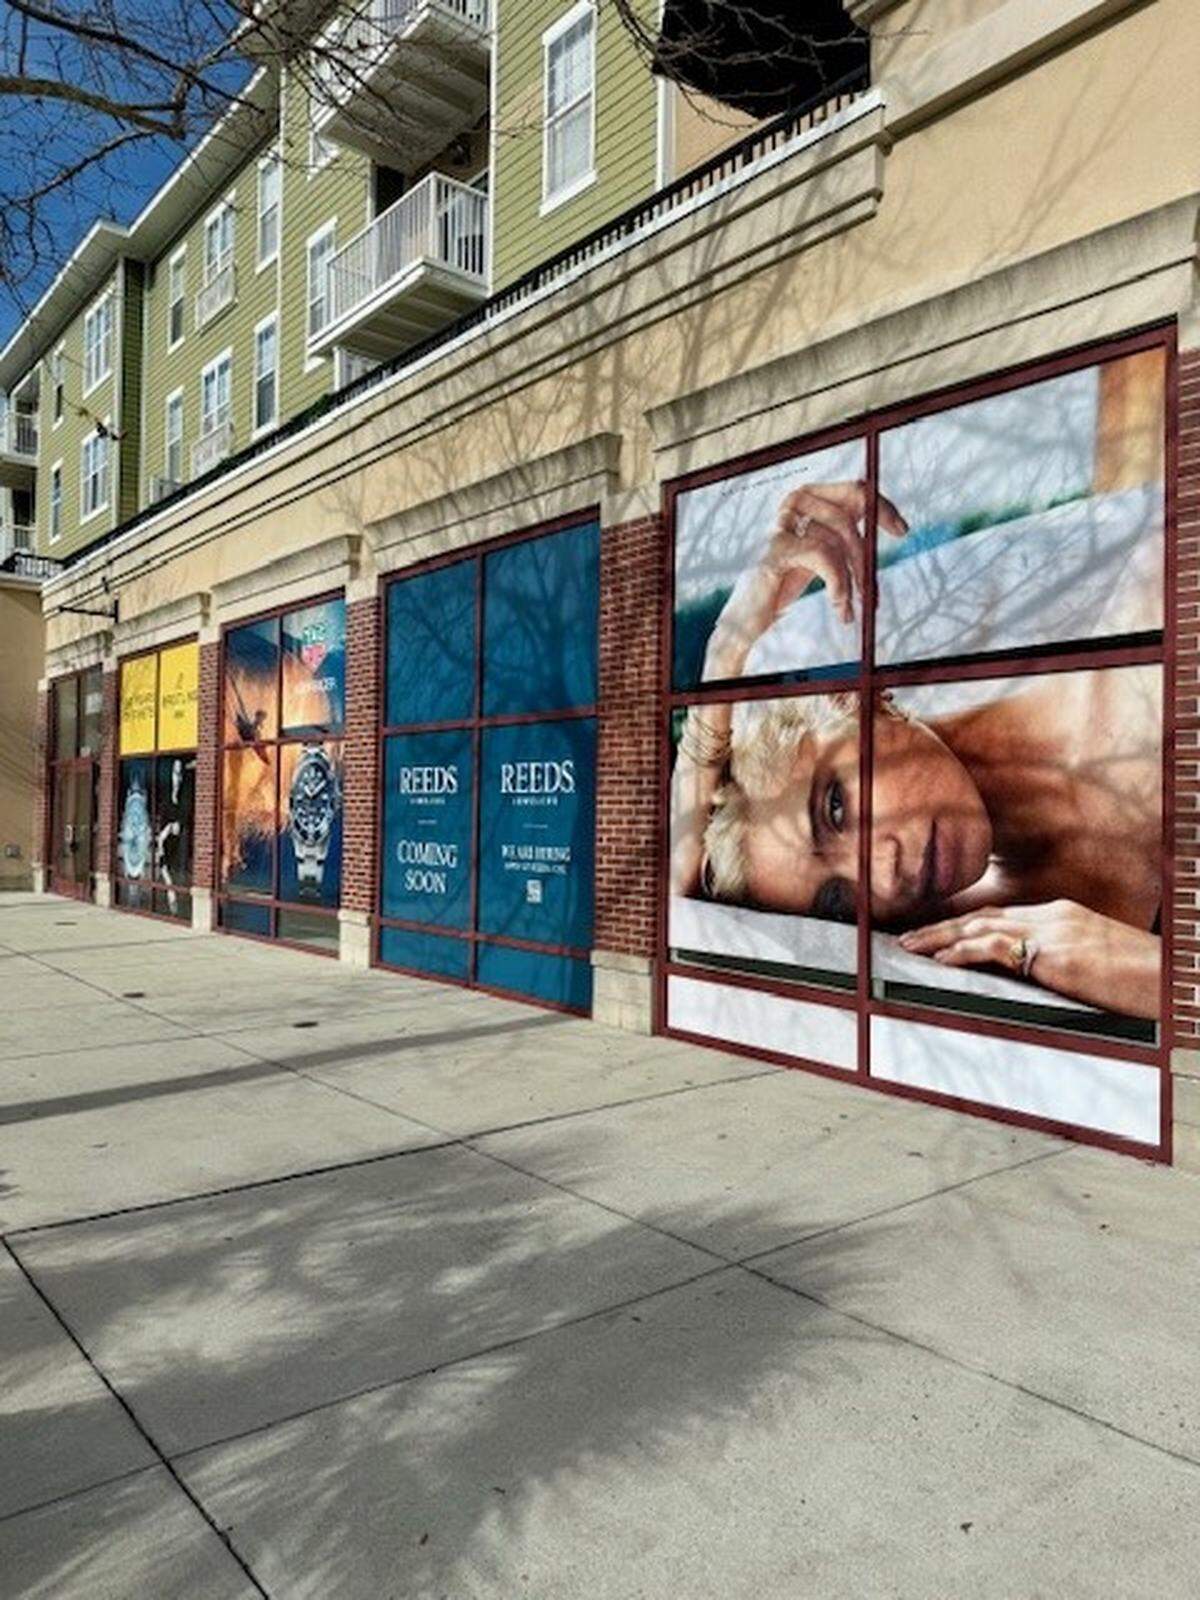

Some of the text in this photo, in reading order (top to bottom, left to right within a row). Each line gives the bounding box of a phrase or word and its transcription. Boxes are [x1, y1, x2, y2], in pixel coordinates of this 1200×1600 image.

[400, 765, 458, 794] REEDS
[500, 760, 574, 793] REEDS
[397, 839, 458, 868] COMING
[405, 870, 446, 894] SOON
